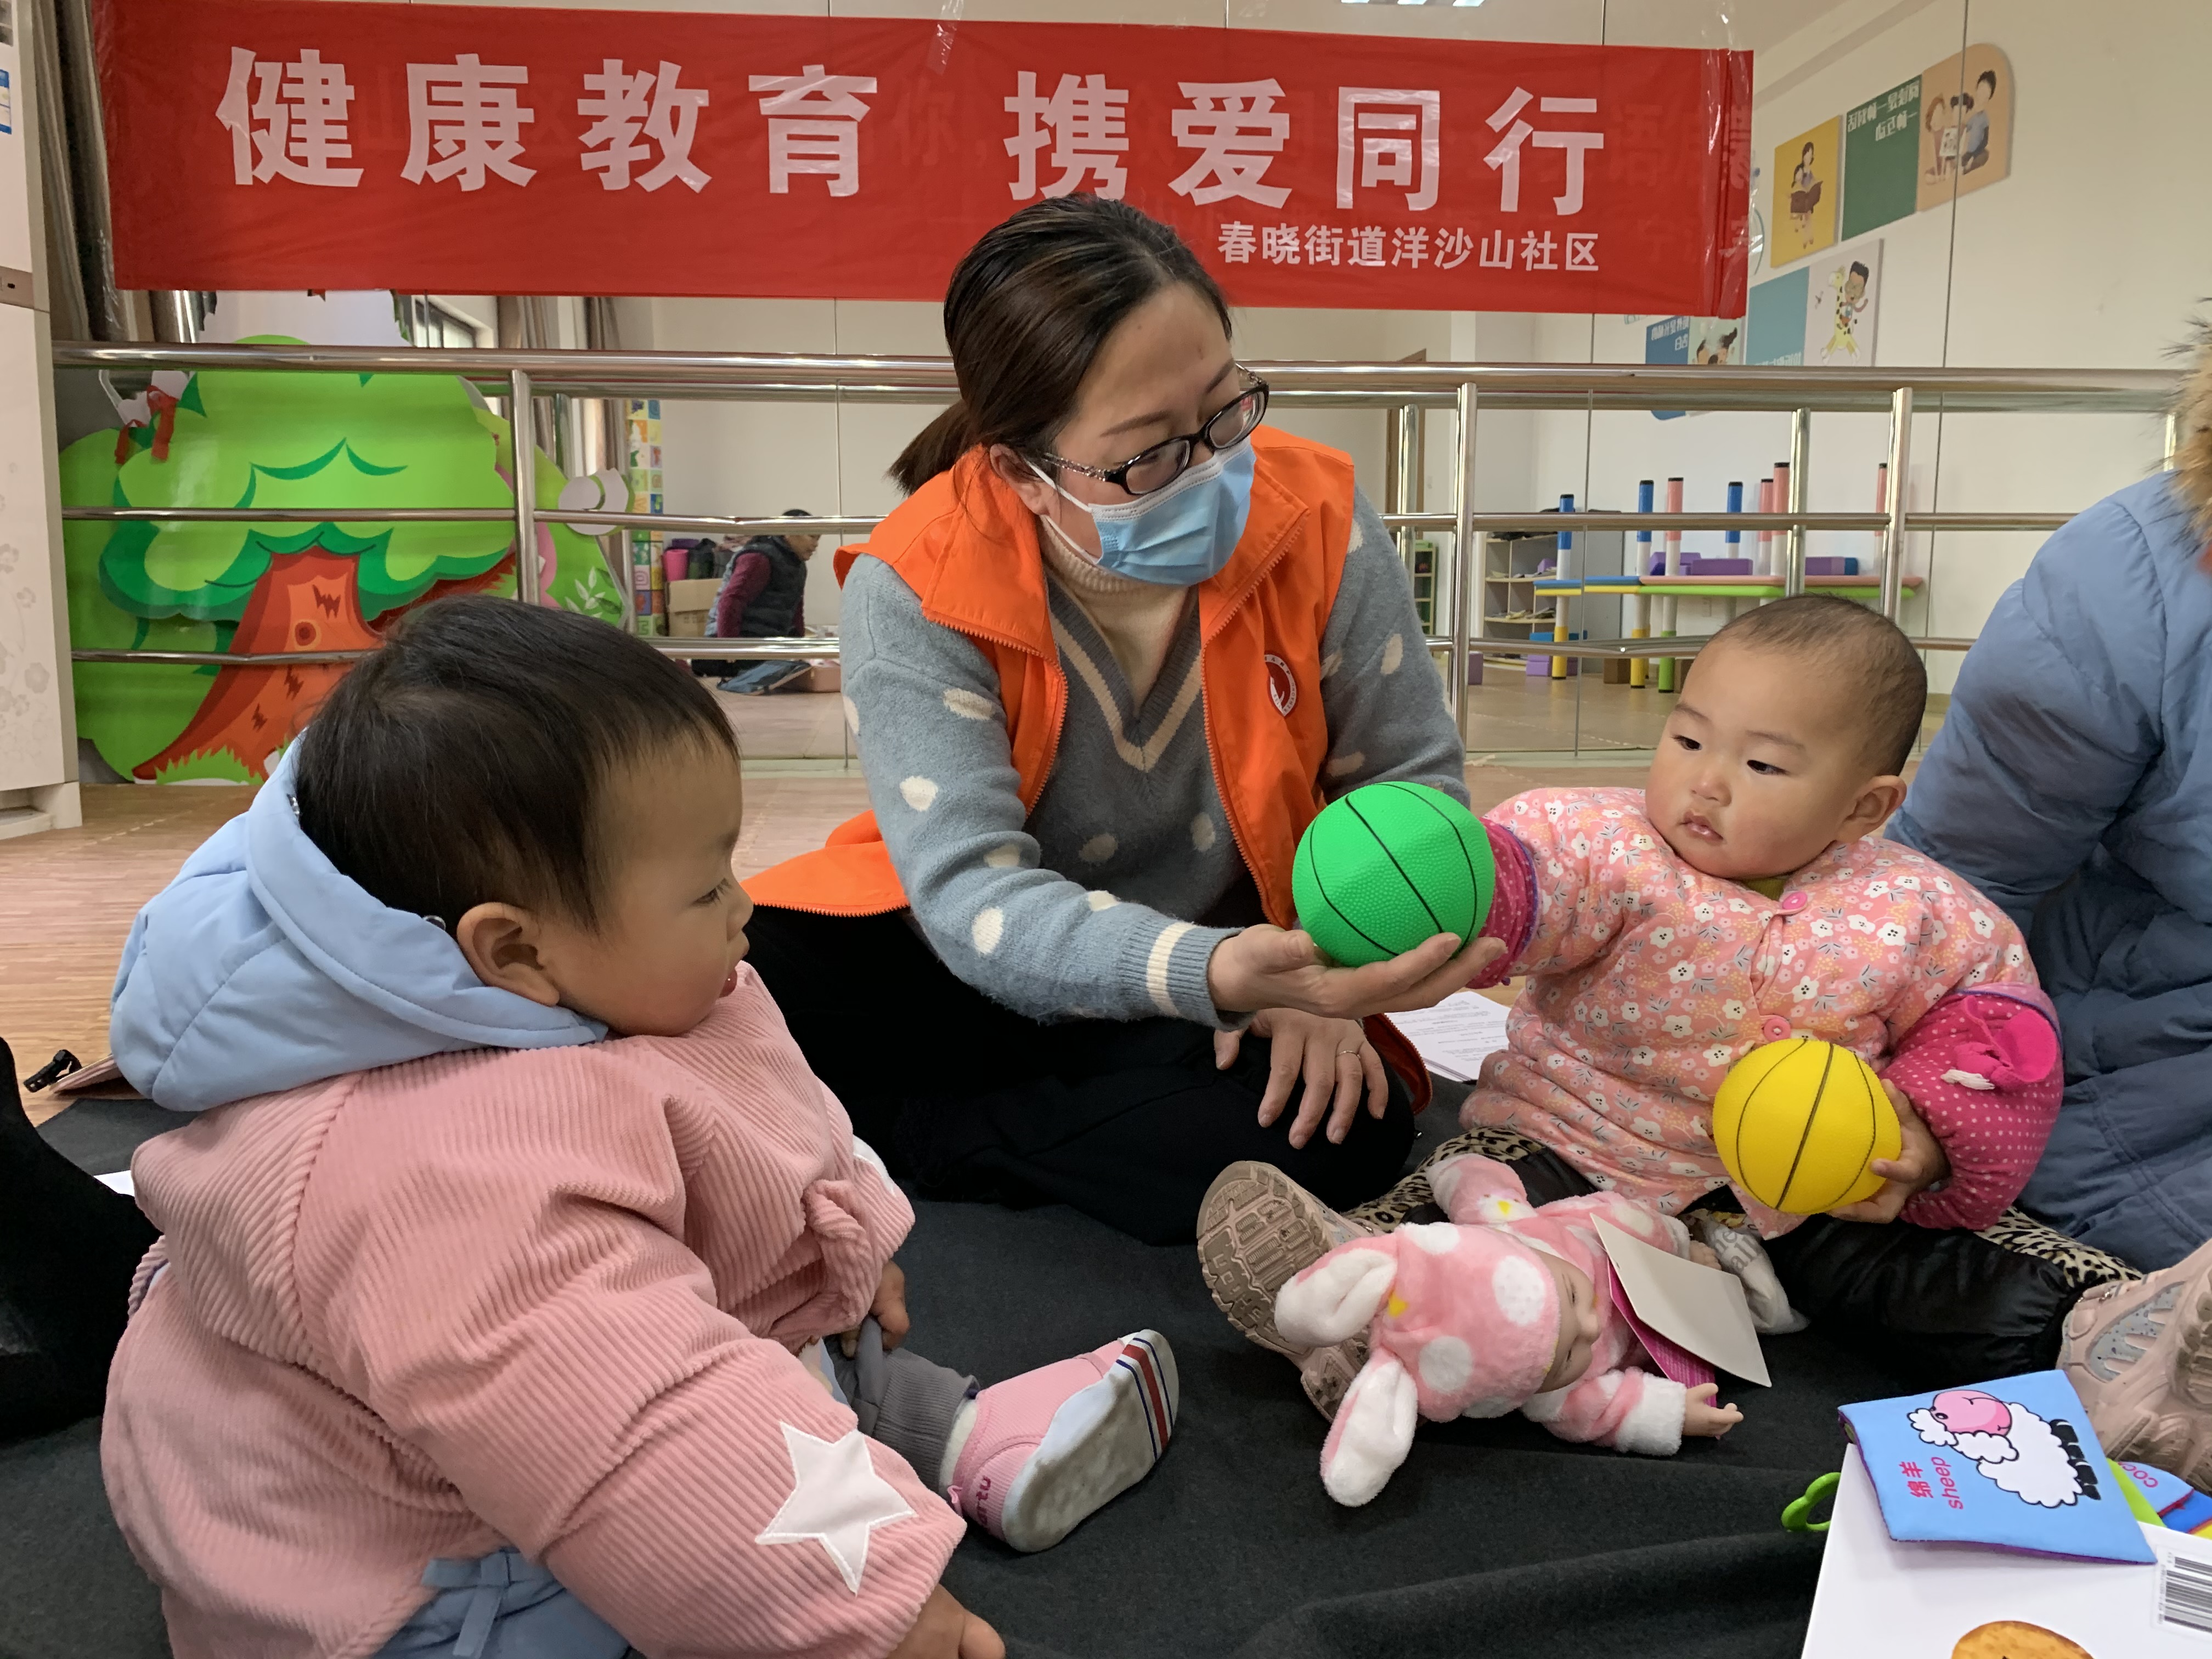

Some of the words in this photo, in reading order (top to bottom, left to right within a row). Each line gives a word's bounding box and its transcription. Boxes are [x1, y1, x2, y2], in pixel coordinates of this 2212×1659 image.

[216, 47, 877, 196] 健康教育
[1003, 71, 1604, 215] 携爱同行
[1218, 221, 1598, 270] 春晓街道洋沙山社区
[1901, 1461, 1932, 1499] 绵羊
[1931, 1457, 1964, 1510] sheep
[2118, 1462, 2159, 1489] coc
